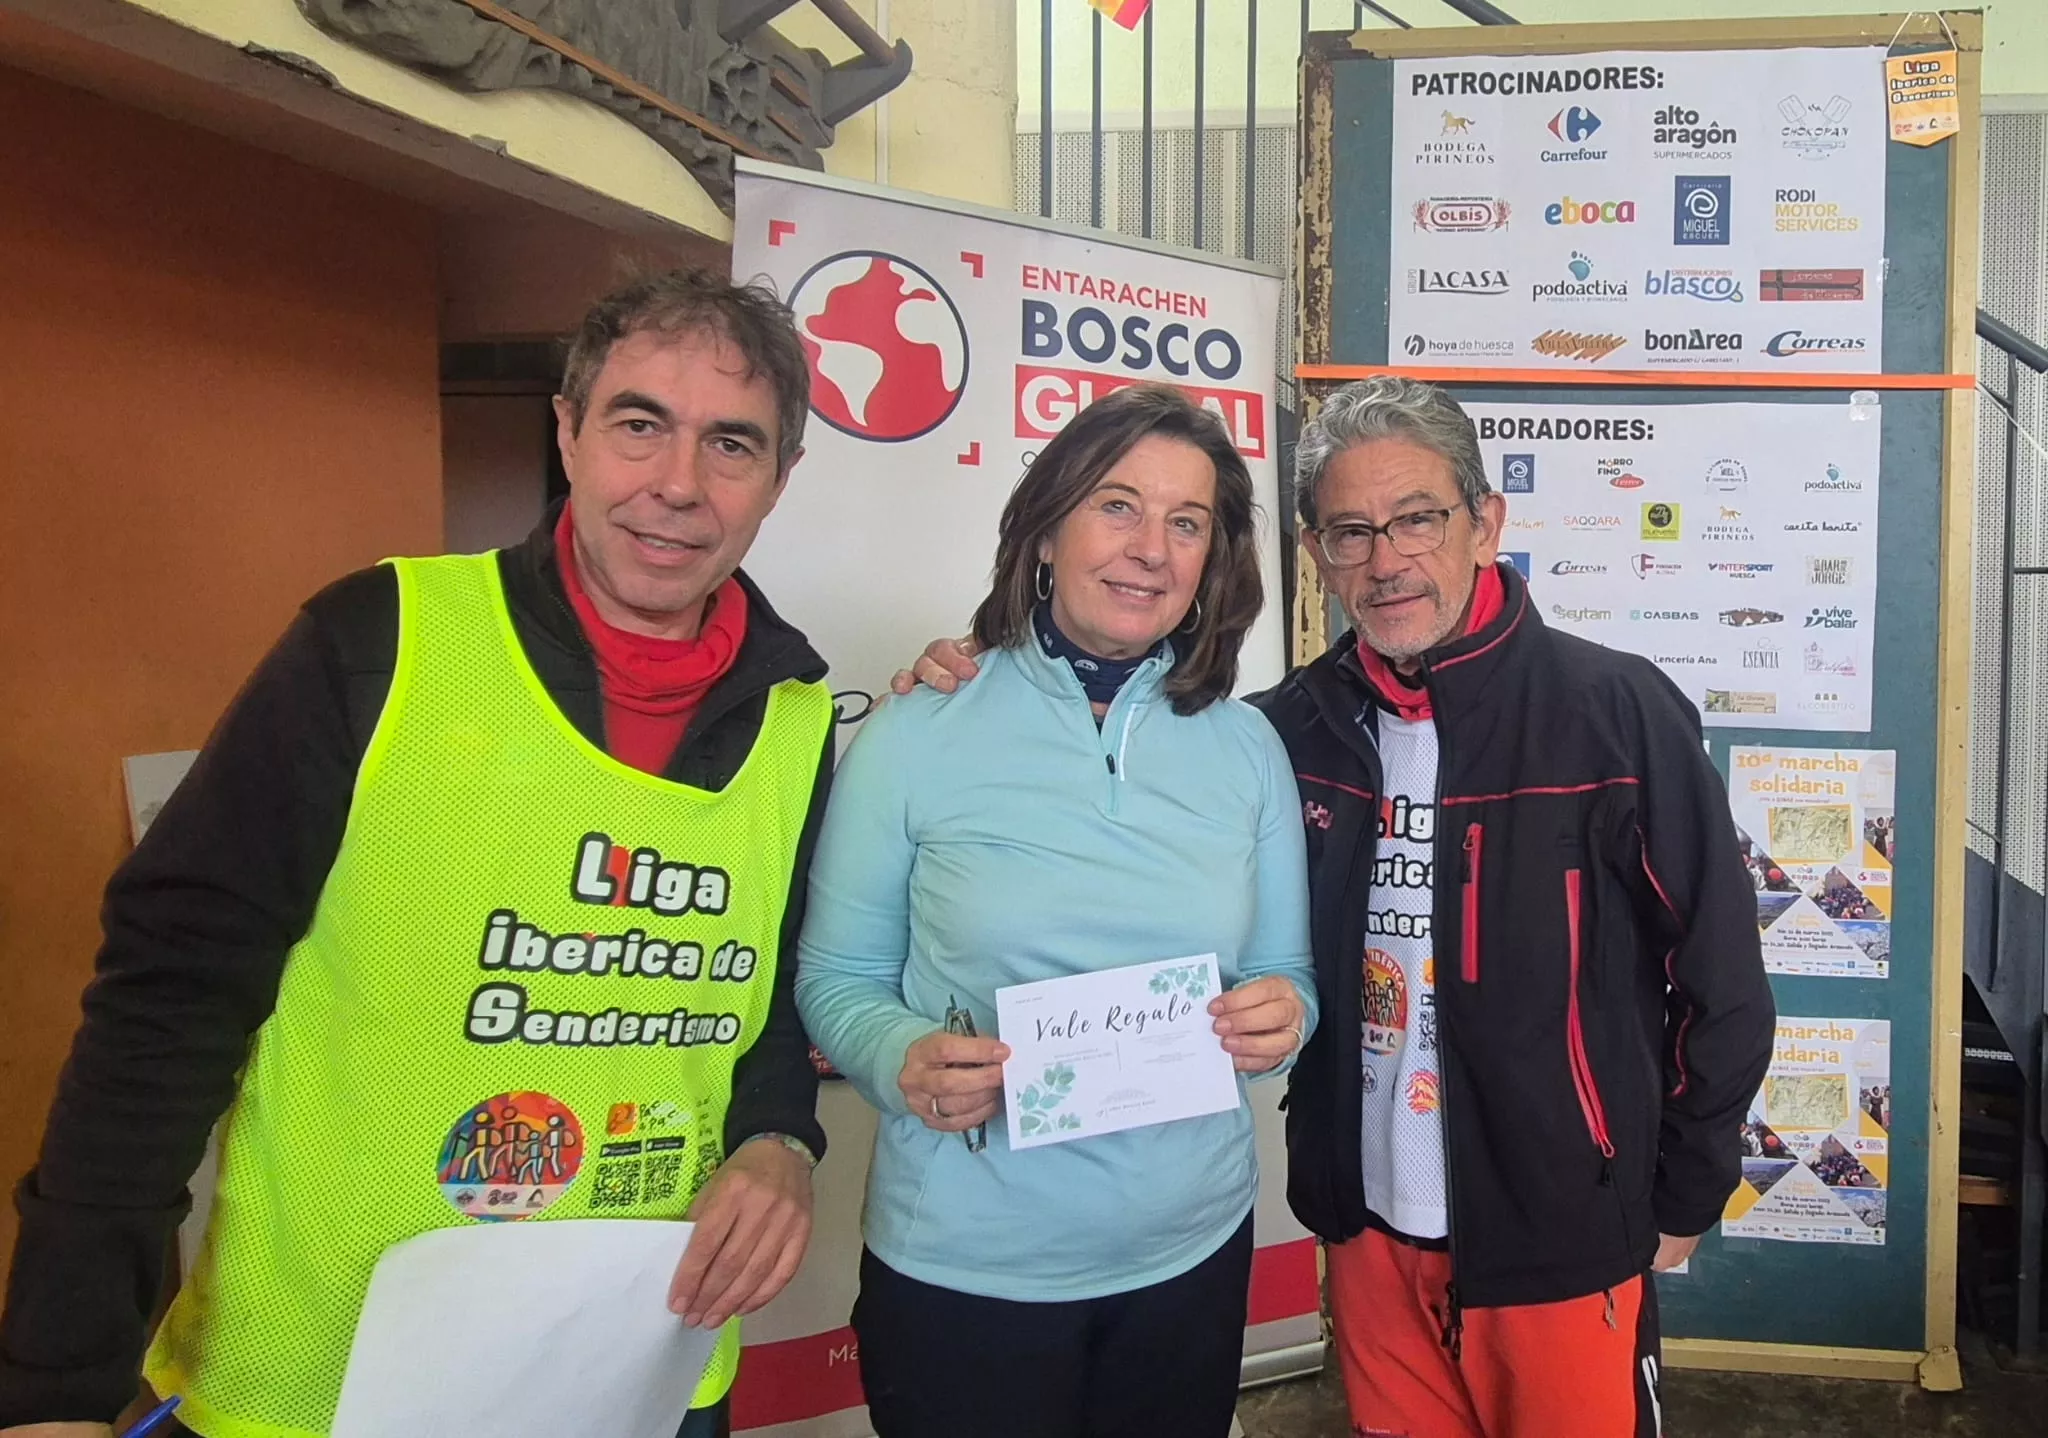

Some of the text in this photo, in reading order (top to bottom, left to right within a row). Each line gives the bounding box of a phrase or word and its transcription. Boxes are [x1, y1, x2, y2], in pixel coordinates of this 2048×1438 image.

[1904, 61, 1940, 74] Liga
[1412, 66, 1664, 96] PATROCINADORES:
[1654, 105, 1699, 125] alto
[1424, 143, 1486, 152] BODEGA
[1540, 148, 1607, 162] Carrefour
[1653, 151, 1733, 159] SUPERMERCADOS
[1416, 154, 1495, 164] PIRINEOS
[1776, 189, 1815, 202] RODI
[1545, 196, 1635, 225] eboca
[1776, 204, 1838, 217] MOTOR
[1683, 219, 1720, 232] MIGUEL
[1775, 218, 1858, 232] SERVICES
[1419, 269, 1510, 294] LACASA
[1645, 269, 1734, 295] blasco
[1022, 264, 1207, 319] ENTARACHEN
[1533, 280, 1628, 302] podoactiva
[1022, 298, 1242, 381] BOSCO
[1429, 338, 1514, 352] hoya de huesca
[1766, 330, 1866, 357] Correas
[1476, 417, 1654, 441] BORADORES:
[1598, 458, 1633, 467] MORRO
[1804, 480, 1862, 492] podoactiva
[1563, 516, 1621, 526] SAQQARA
[1784, 521, 1818, 532] carita
[1551, 560, 1608, 575] Correas
[1719, 564, 1774, 572] INTERSPORT
[1812, 572, 1845, 584] JORGE
[1558, 607, 1611, 622] Seytam
[1643, 611, 1699, 620] CASBAS
[1825, 606, 1852, 617] vive
[1824, 617, 1858, 629] balar
[1654, 655, 1717, 664] Lencería Ana
[1743, 650, 1779, 669] ESENCIA
[1779, 752, 1859, 772] marcha
[1750, 774, 1844, 795] solidaria
[1378, 796, 1434, 843] ig
[572, 834, 730, 915] Liga
[710, 941, 755, 981] de
[466, 983, 740, 1045] Senderismo
[1036, 1009, 1092, 1042] Vale
[1775, 1022, 1854, 1041] marcha
